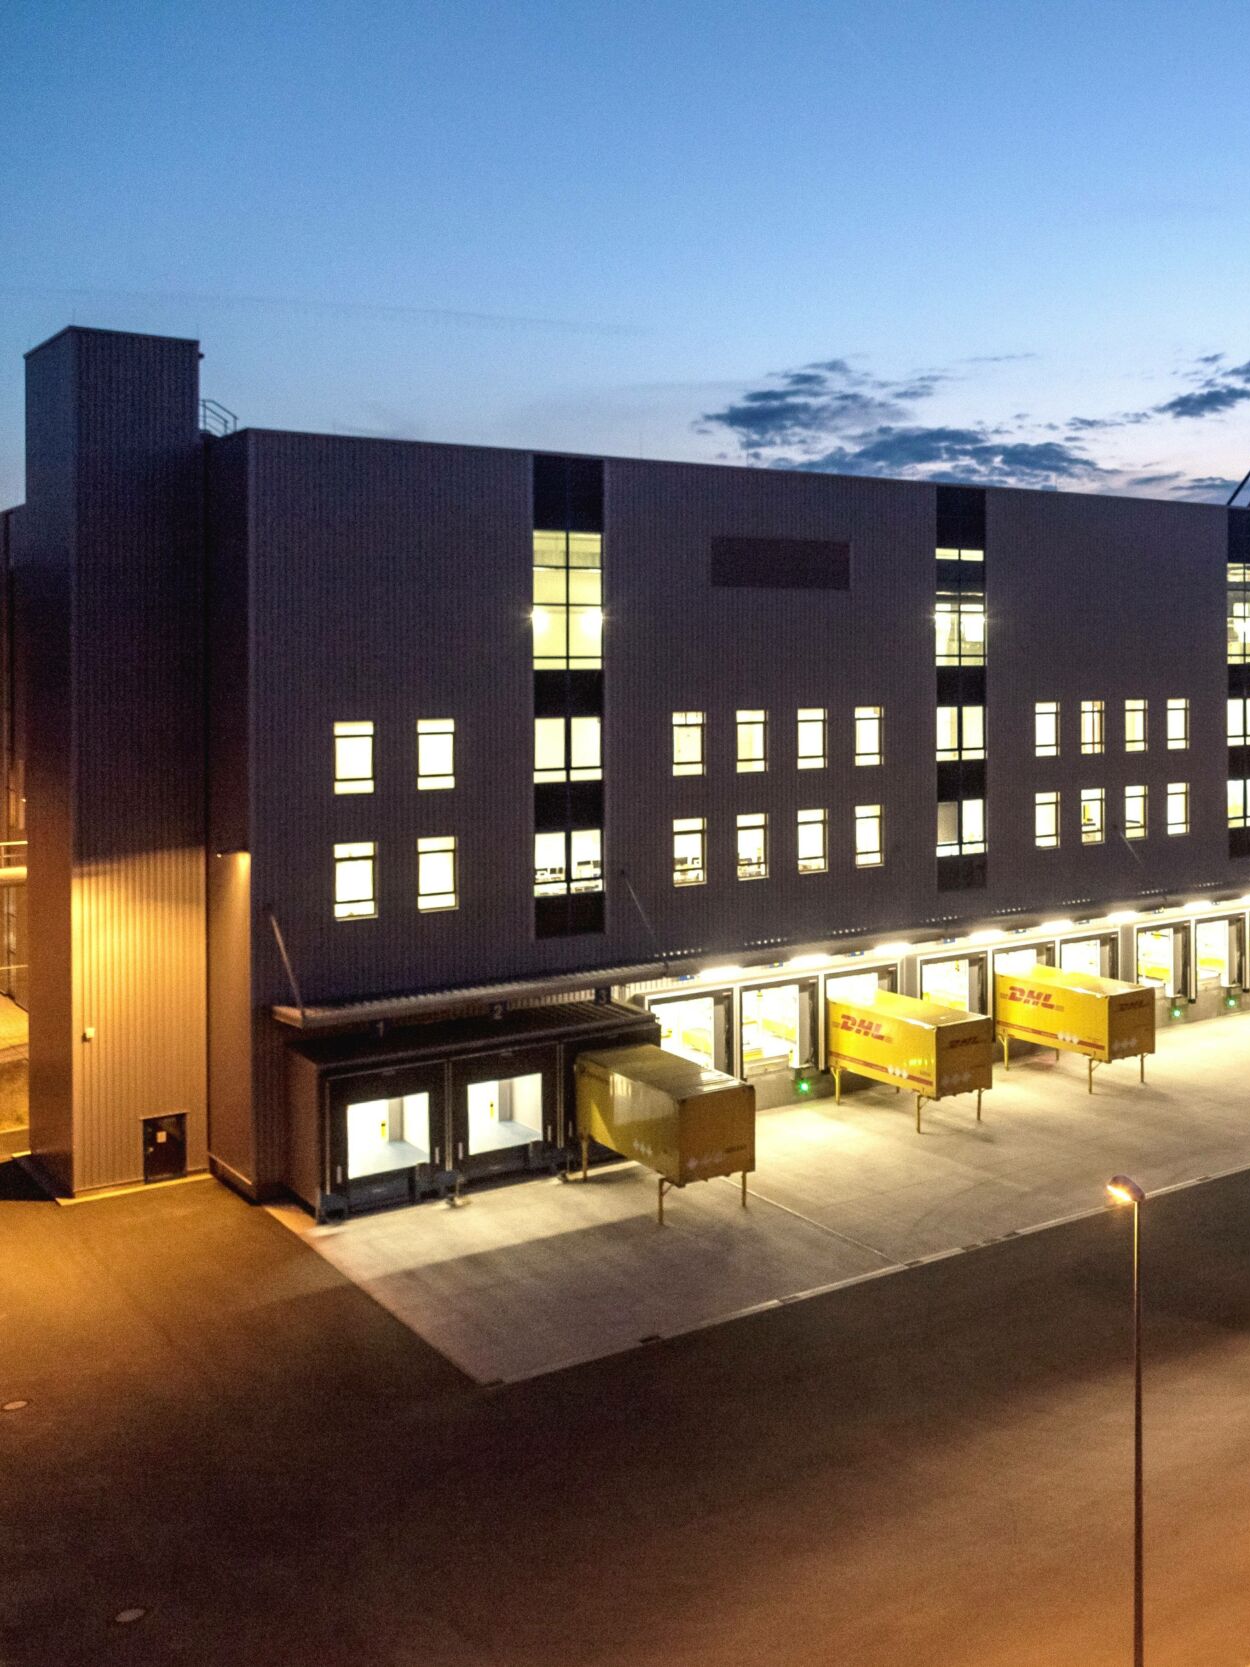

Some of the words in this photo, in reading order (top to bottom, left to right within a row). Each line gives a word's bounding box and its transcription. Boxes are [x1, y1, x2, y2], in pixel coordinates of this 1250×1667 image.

[1008, 985, 1055, 1010] DHL
[493, 1004, 503, 1019] 2
[840, 1013, 886, 1041] DHL
